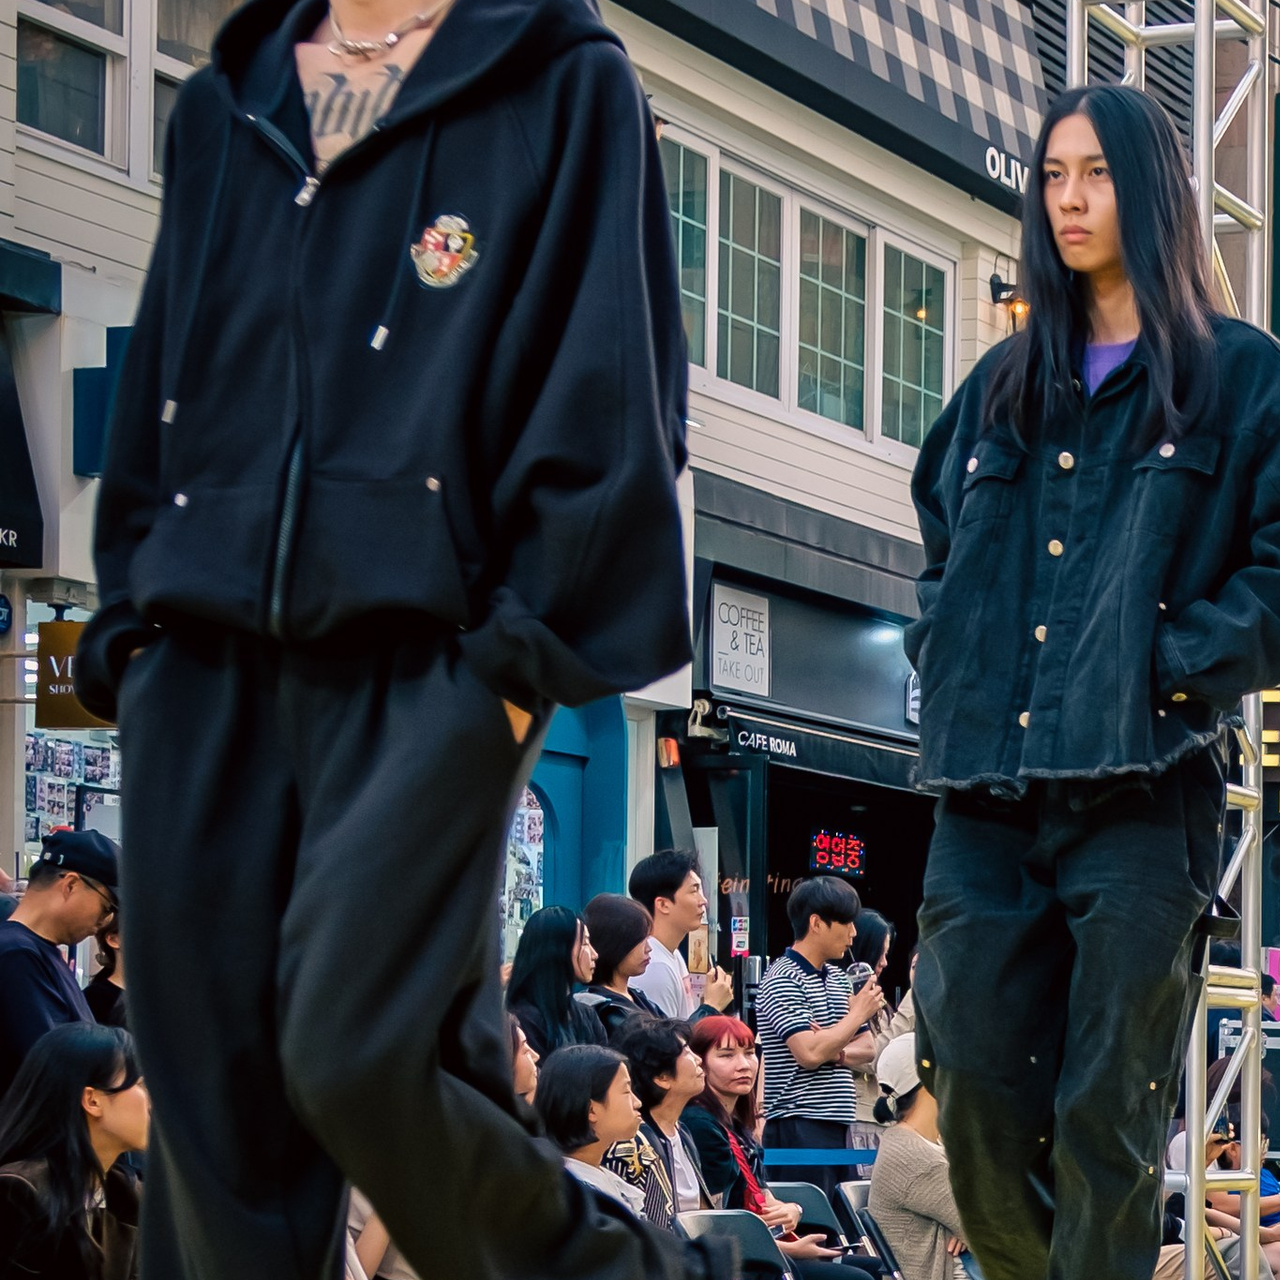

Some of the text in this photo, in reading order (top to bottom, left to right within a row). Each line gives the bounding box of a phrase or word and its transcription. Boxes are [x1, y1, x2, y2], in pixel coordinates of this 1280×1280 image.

[718, 602, 765, 633] COFFEE
[730, 630, 765, 658] & TEA
[718, 657, 765, 685] TAKE OUT
[738, 731, 797, 757] CAFE ROMA
[816, 833, 861, 868] 영업중
